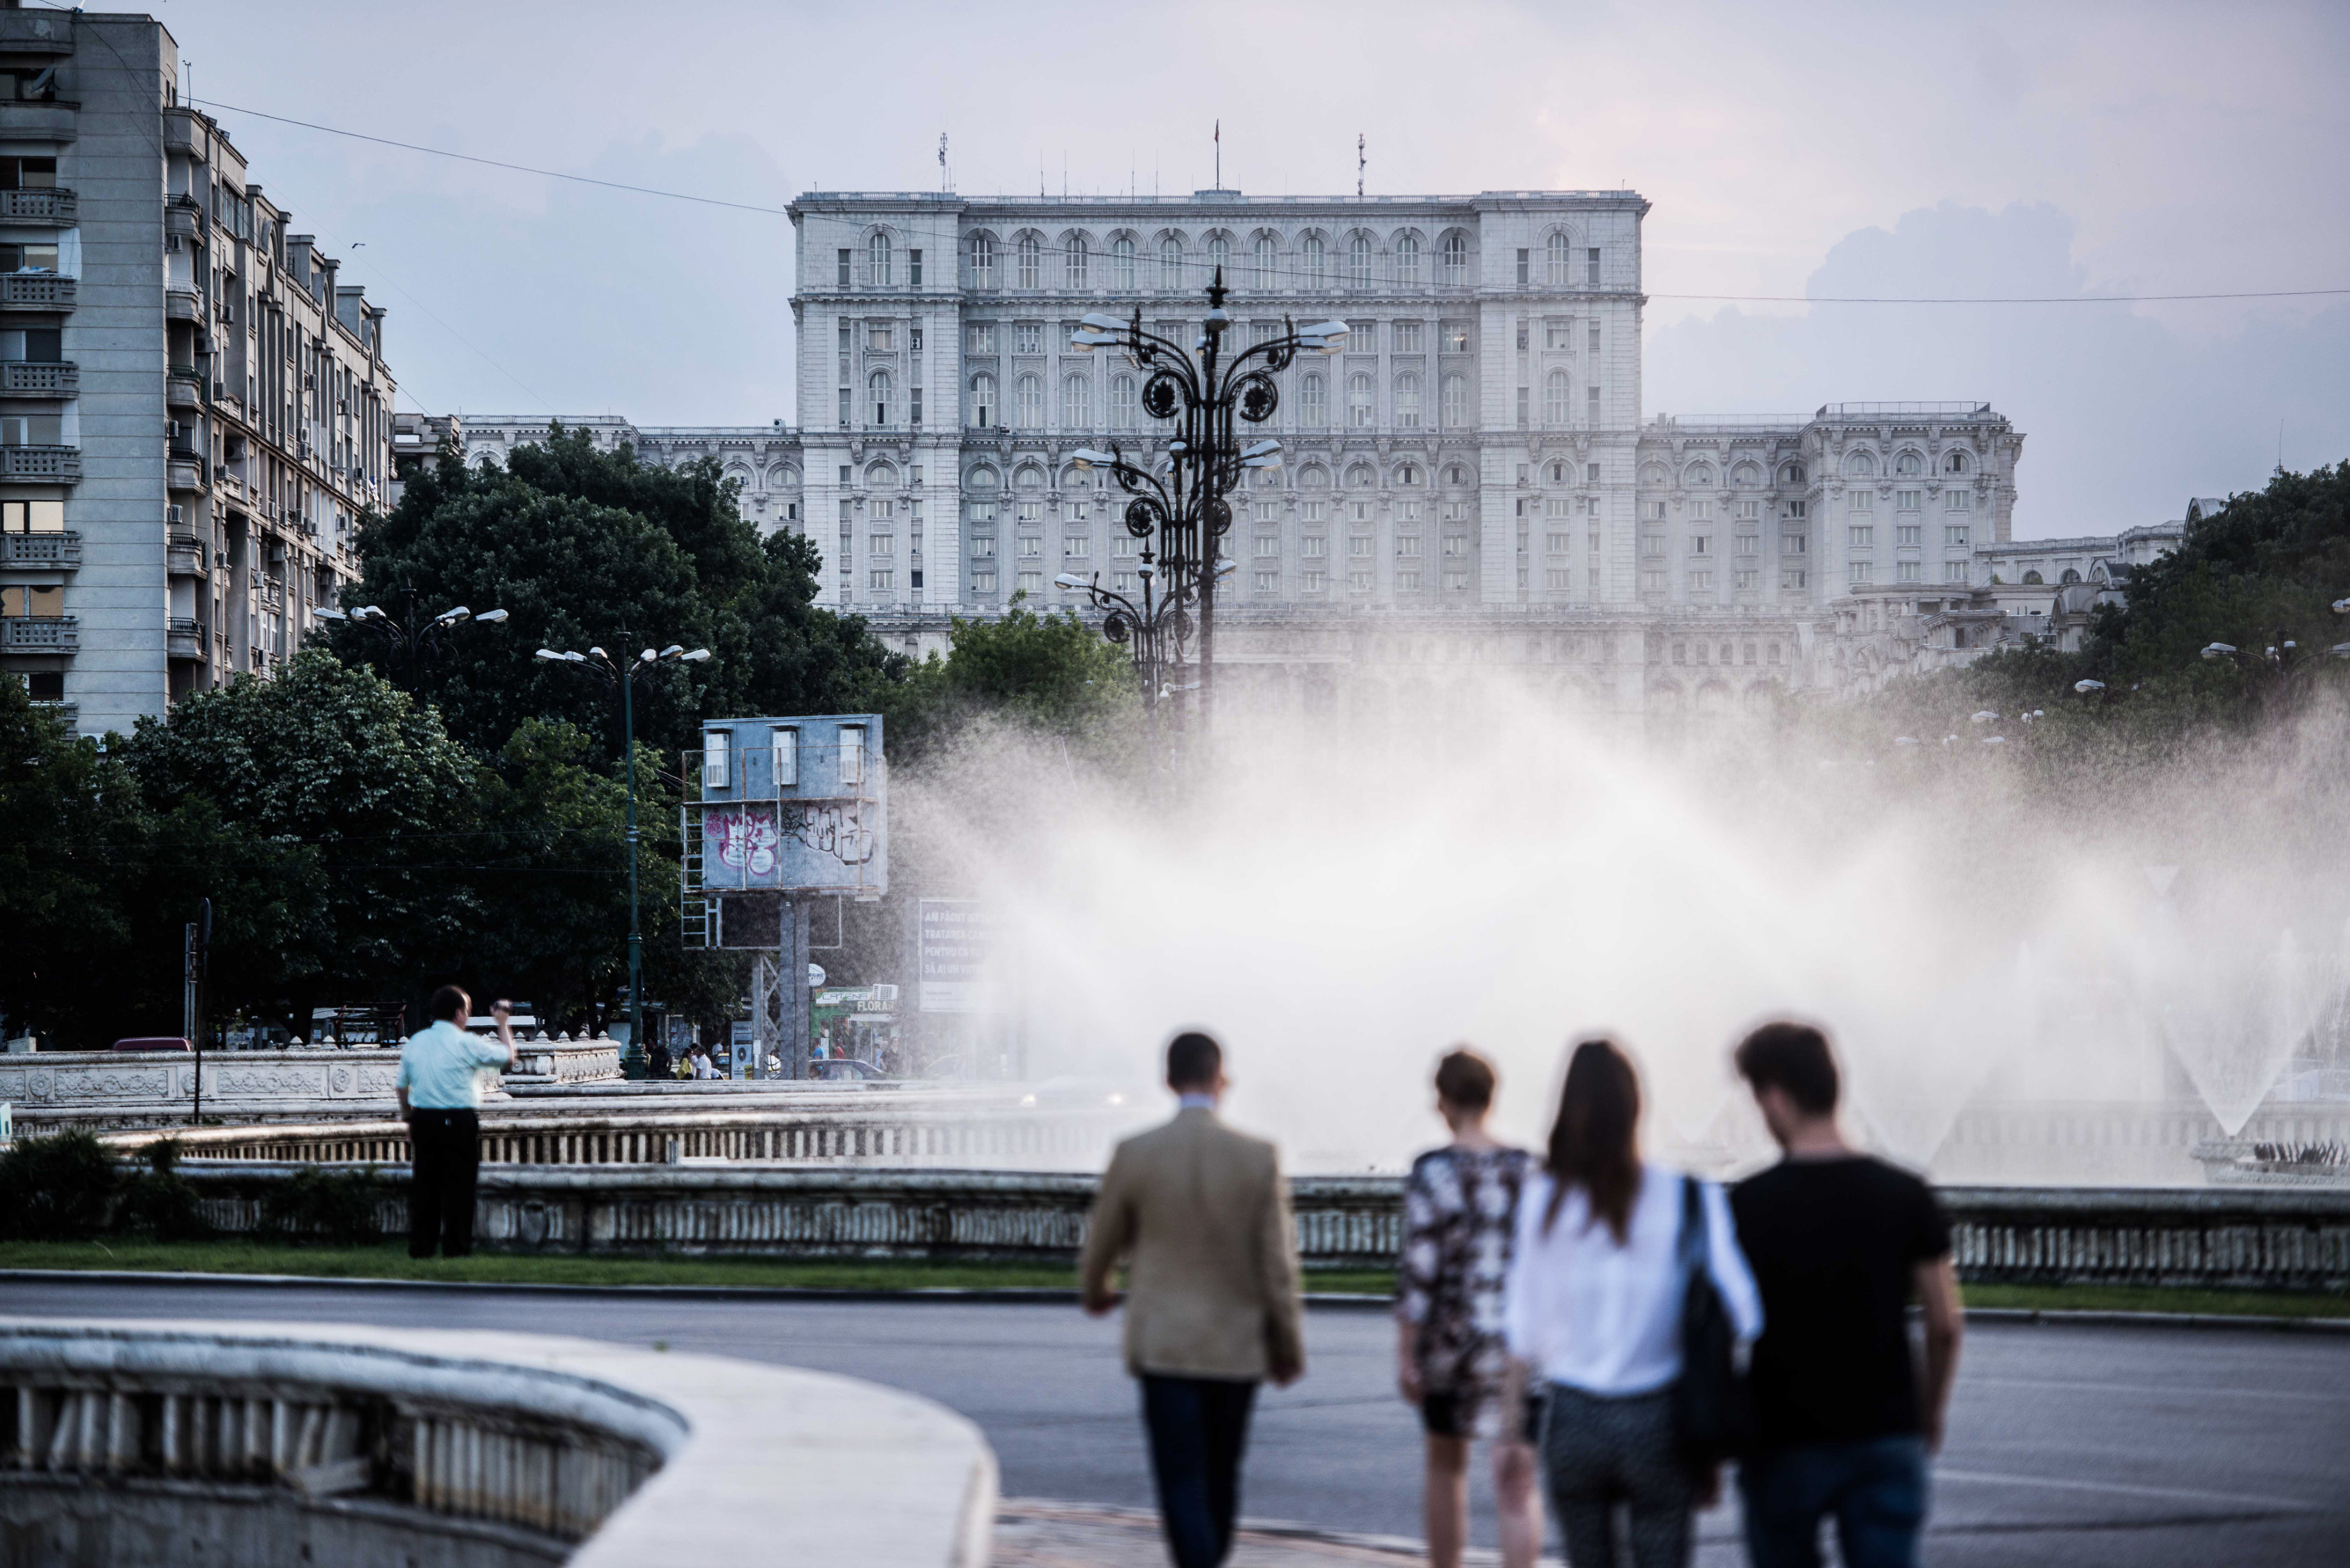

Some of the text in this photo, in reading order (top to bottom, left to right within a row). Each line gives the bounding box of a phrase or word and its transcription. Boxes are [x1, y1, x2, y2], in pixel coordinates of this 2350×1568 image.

[925, 912, 938, 922] AM
[940, 910, 966, 922] FĂCUT
[925, 930, 966, 939] TRATAREA
[925, 947, 981, 957] PENTRU CA TU
[925, 961, 936, 974] SĂ
[937, 964, 946, 974] AI
[947, 965, 959, 974] UN
